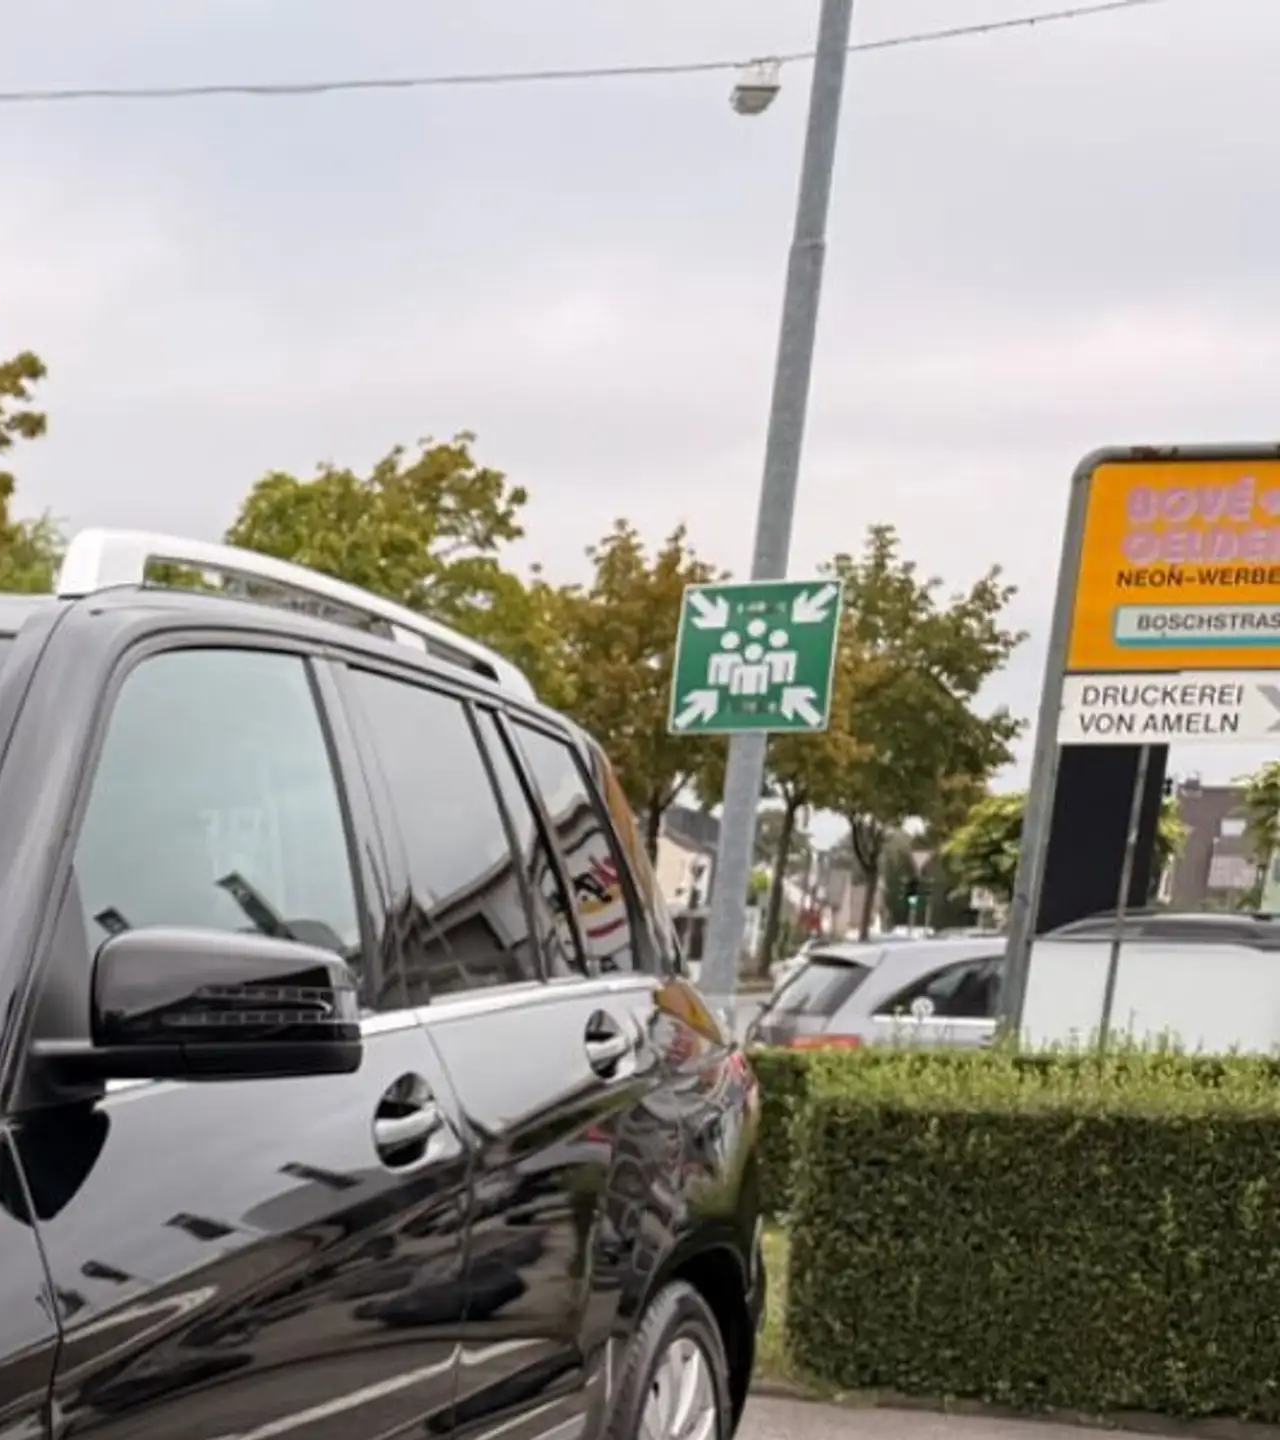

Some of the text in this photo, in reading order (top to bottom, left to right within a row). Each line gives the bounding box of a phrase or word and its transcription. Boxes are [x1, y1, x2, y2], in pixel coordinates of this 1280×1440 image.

[1081, 683, 1244, 706] DRUCKEREI
[1079, 712, 1239, 734] VON AMELN
